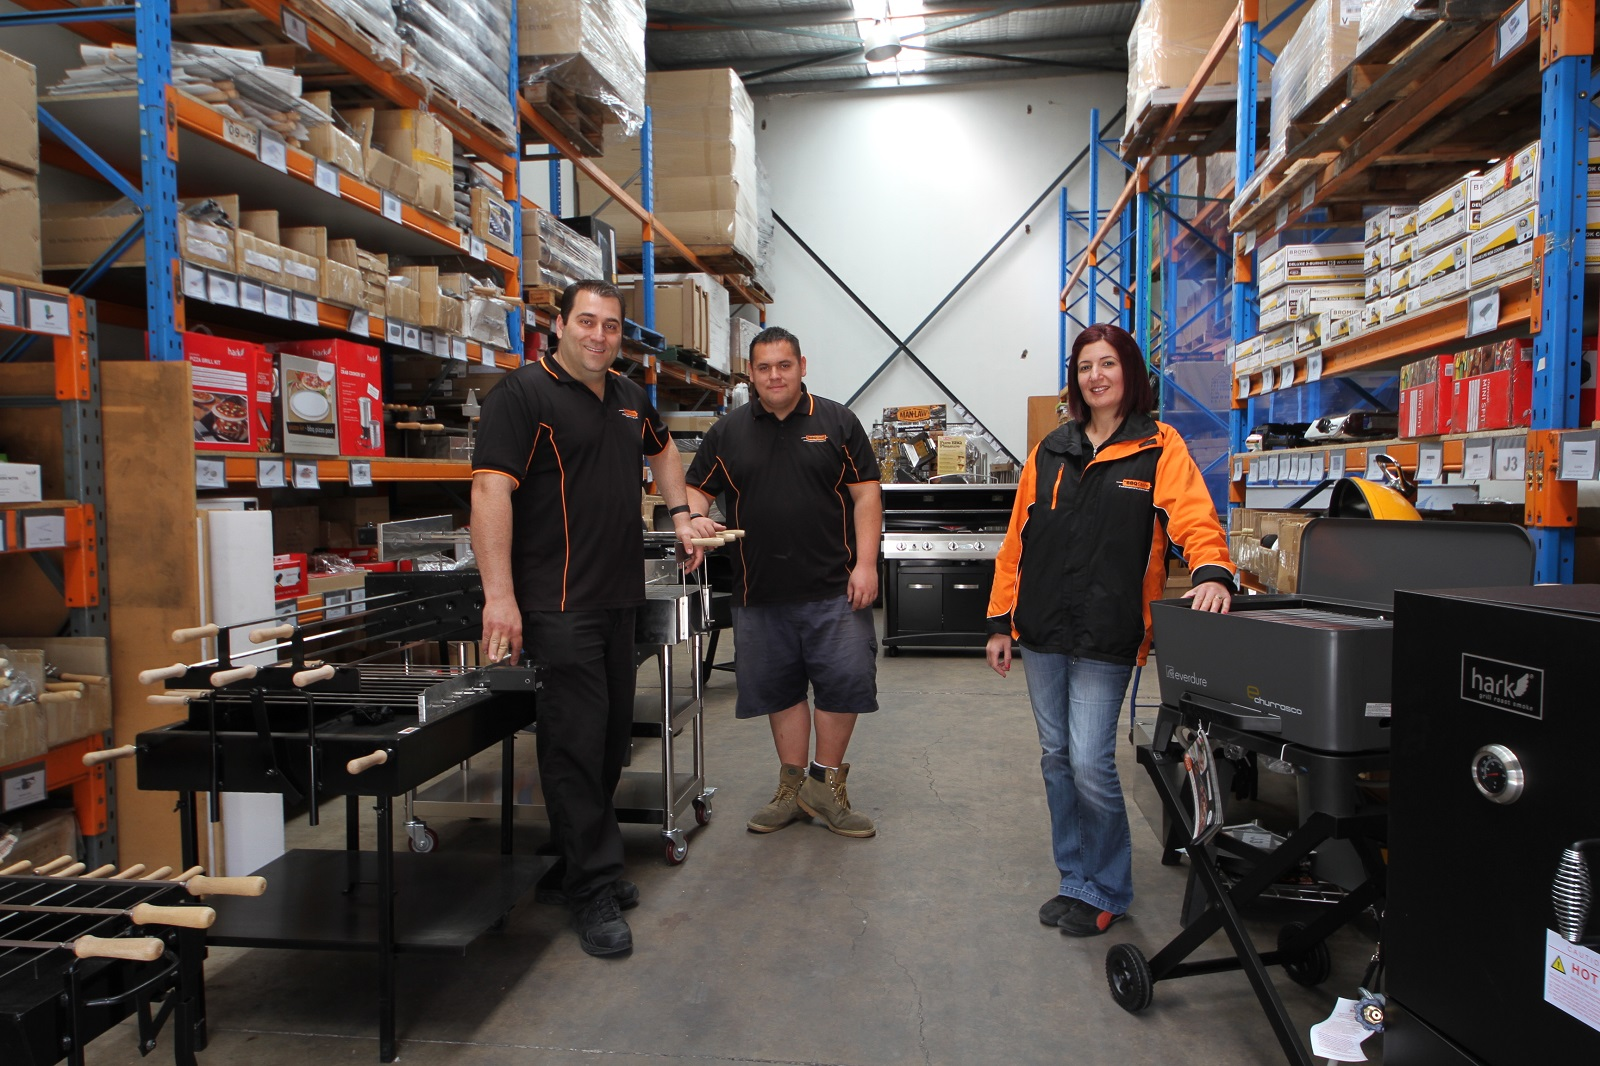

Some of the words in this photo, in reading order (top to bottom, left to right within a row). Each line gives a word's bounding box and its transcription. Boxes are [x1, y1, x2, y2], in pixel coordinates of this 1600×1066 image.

[1502, 456, 1518, 472] J3
[1174, 671, 1208, 687] everdure
[1471, 666, 1515, 699] hark
[1253, 696, 1303, 715] churrasco
[1479, 693, 1492, 701] grill
[1567, 945, 1600, 967] CAUTIO
[1571, 962, 1599, 985] HOT
